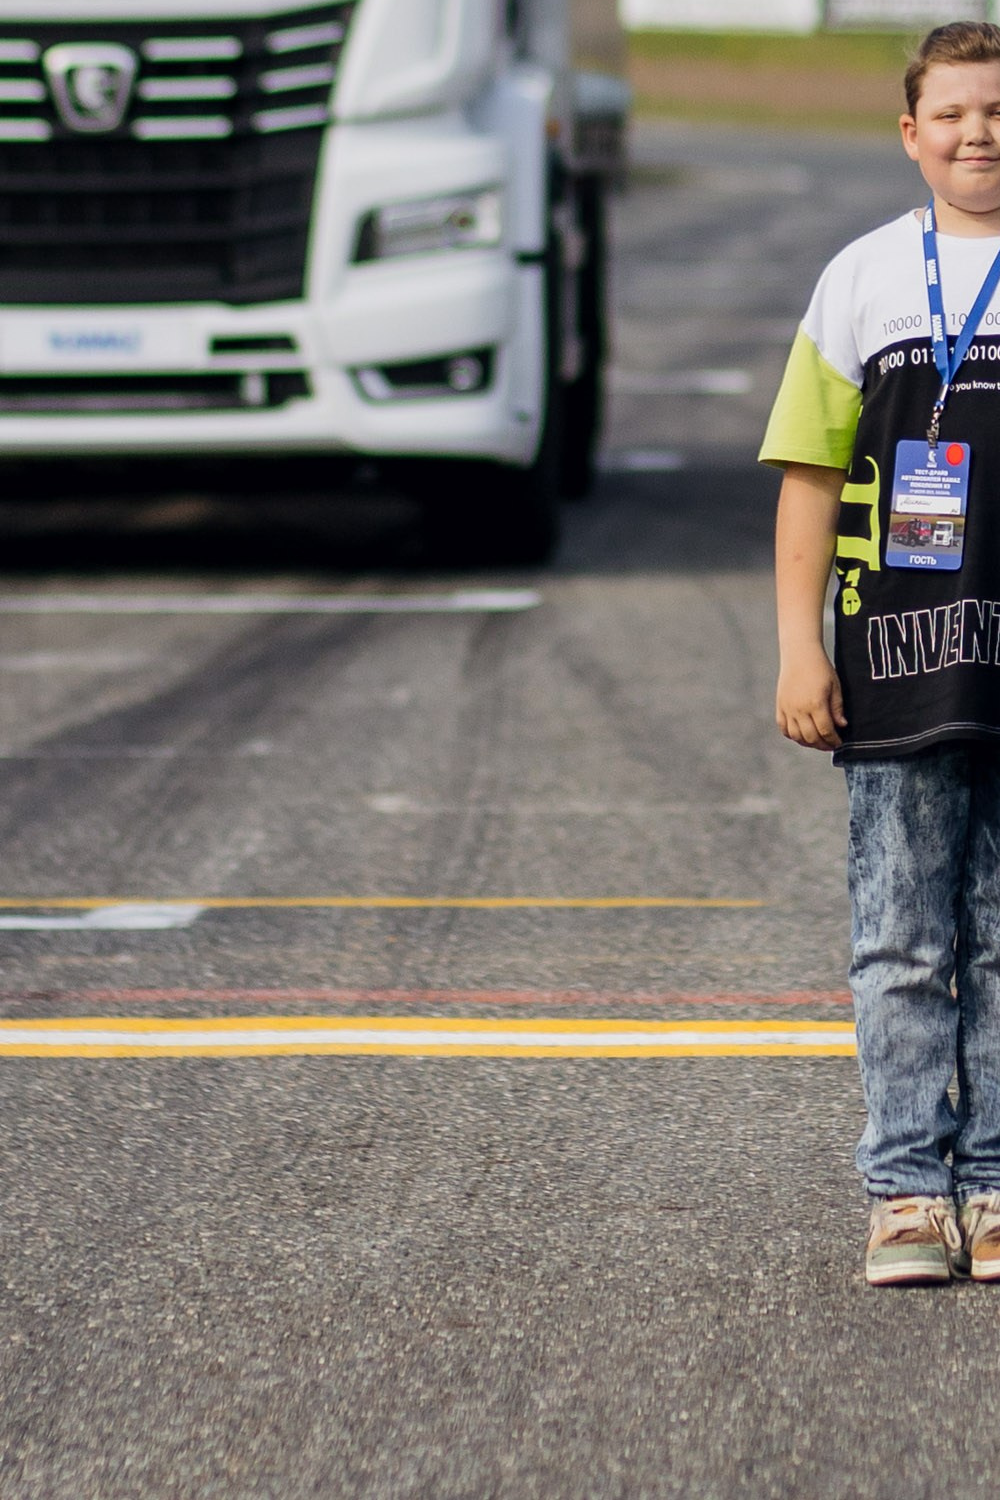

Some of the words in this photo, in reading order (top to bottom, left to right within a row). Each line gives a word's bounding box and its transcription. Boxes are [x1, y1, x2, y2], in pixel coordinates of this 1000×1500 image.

[883, 314, 922, 336] 10000
[956, 384, 971, 392] you
[973, 380, 995, 390] know
[909, 555, 937, 565] ГОСТЬ
